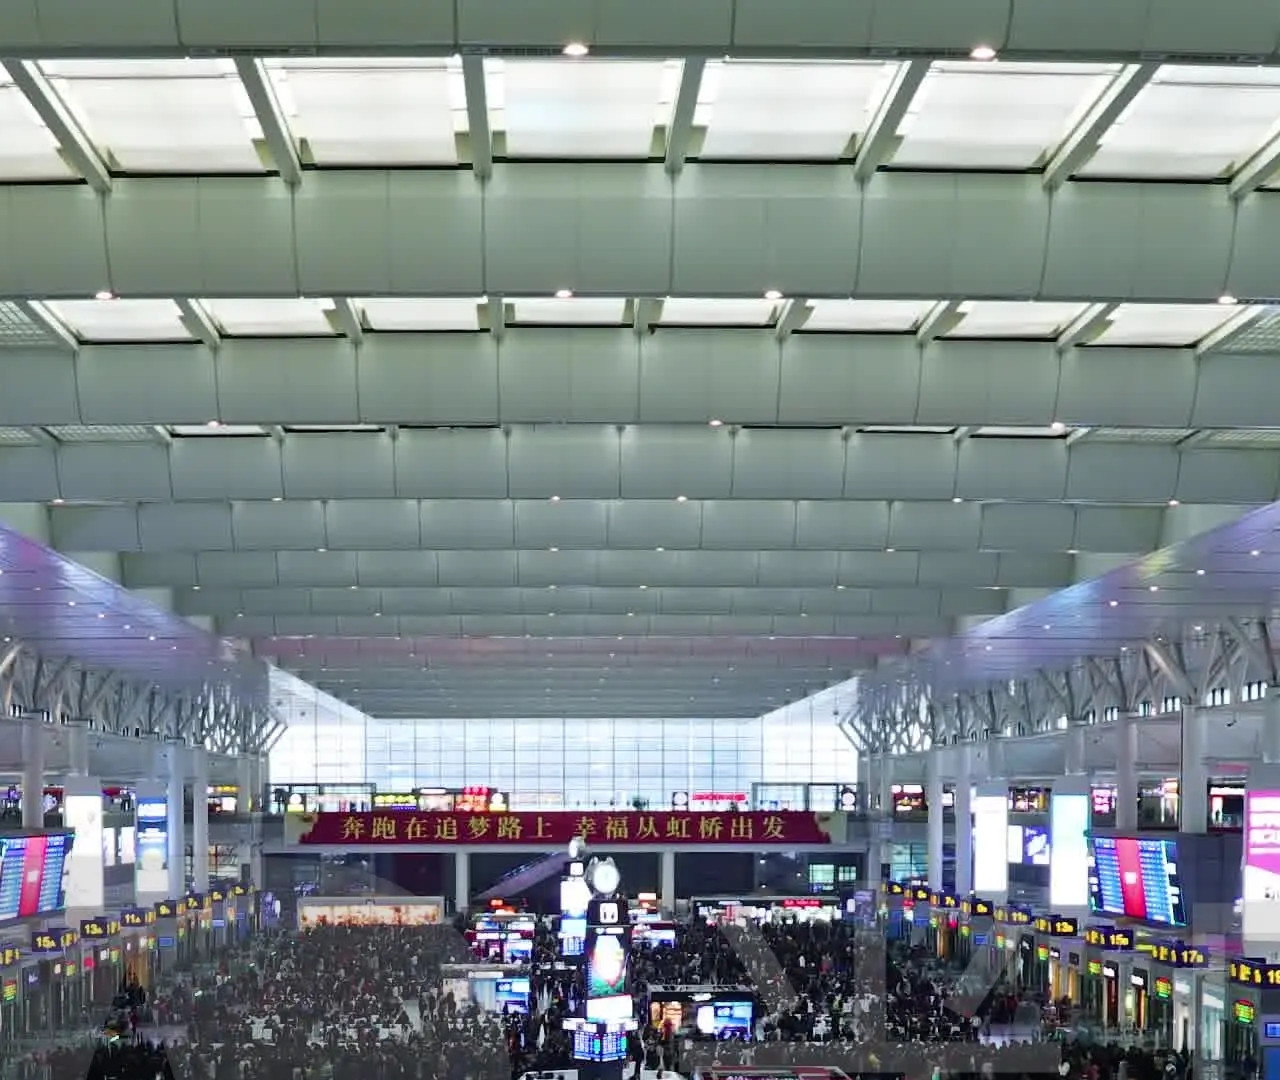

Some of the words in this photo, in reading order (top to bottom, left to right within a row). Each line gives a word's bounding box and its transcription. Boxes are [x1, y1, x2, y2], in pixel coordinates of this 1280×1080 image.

[341, 815, 554, 841] 奔跑在追梦路上
[574, 815, 787, 841] 幸福从虹桥出发
